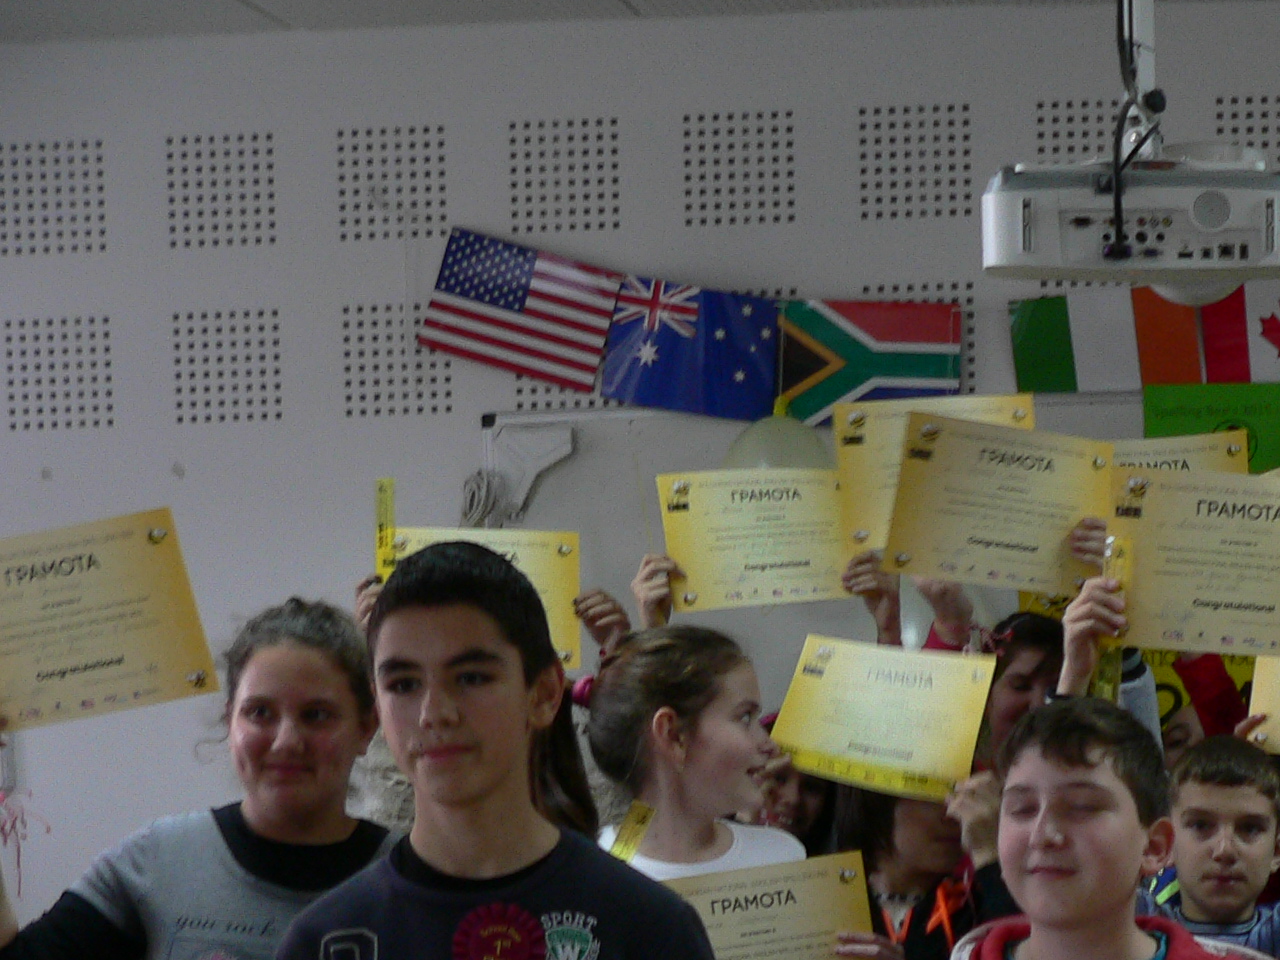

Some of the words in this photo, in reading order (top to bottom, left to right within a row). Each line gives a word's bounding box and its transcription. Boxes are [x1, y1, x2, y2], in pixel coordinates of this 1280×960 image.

[979, 448, 1056, 473] ГРАМОТА
[730, 487, 803, 503] ГРАМОТА
[710, 888, 797, 916] ГРАМОТА
[541, 910, 598, 931] SPORT
